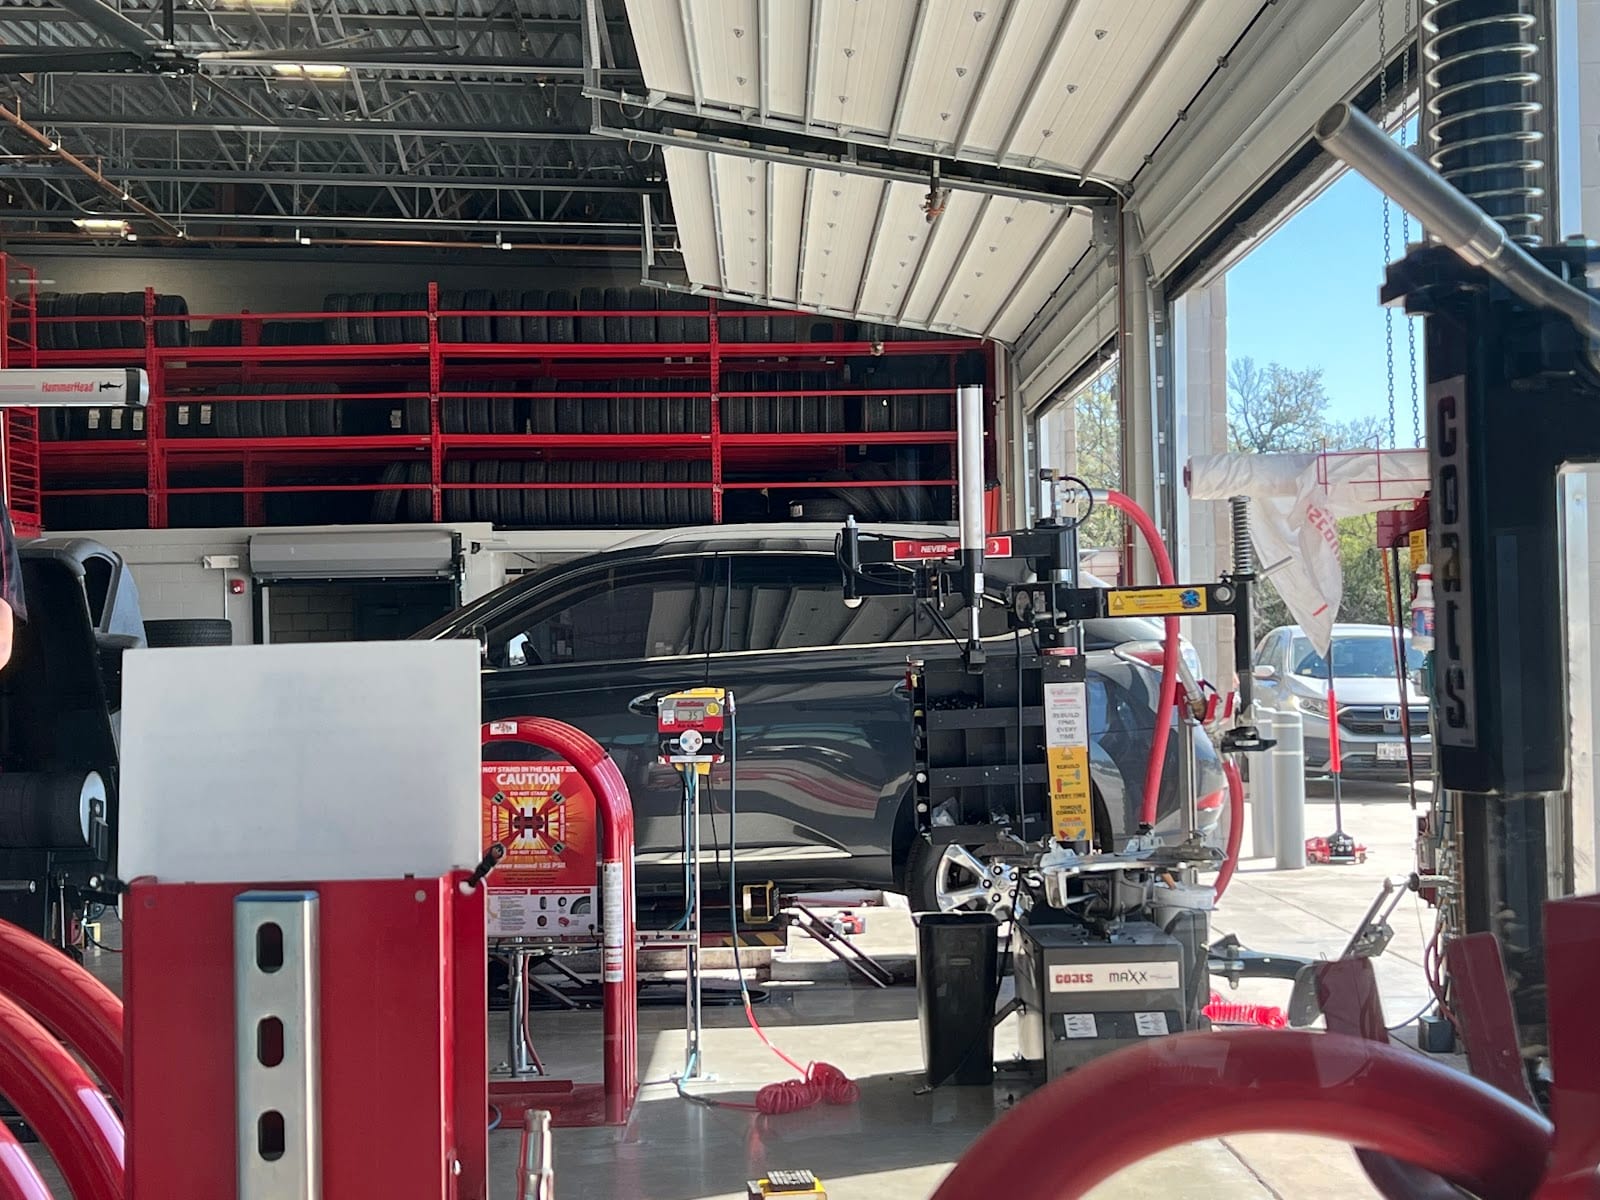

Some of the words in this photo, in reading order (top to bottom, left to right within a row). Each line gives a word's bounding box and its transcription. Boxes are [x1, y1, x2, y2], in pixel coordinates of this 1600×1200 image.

[42, 382, 95, 392] HammerHead
[921, 544, 947, 553] NEVER
[496, 773, 560, 785] CAUTION
[1055, 973, 1094, 984] COATS
